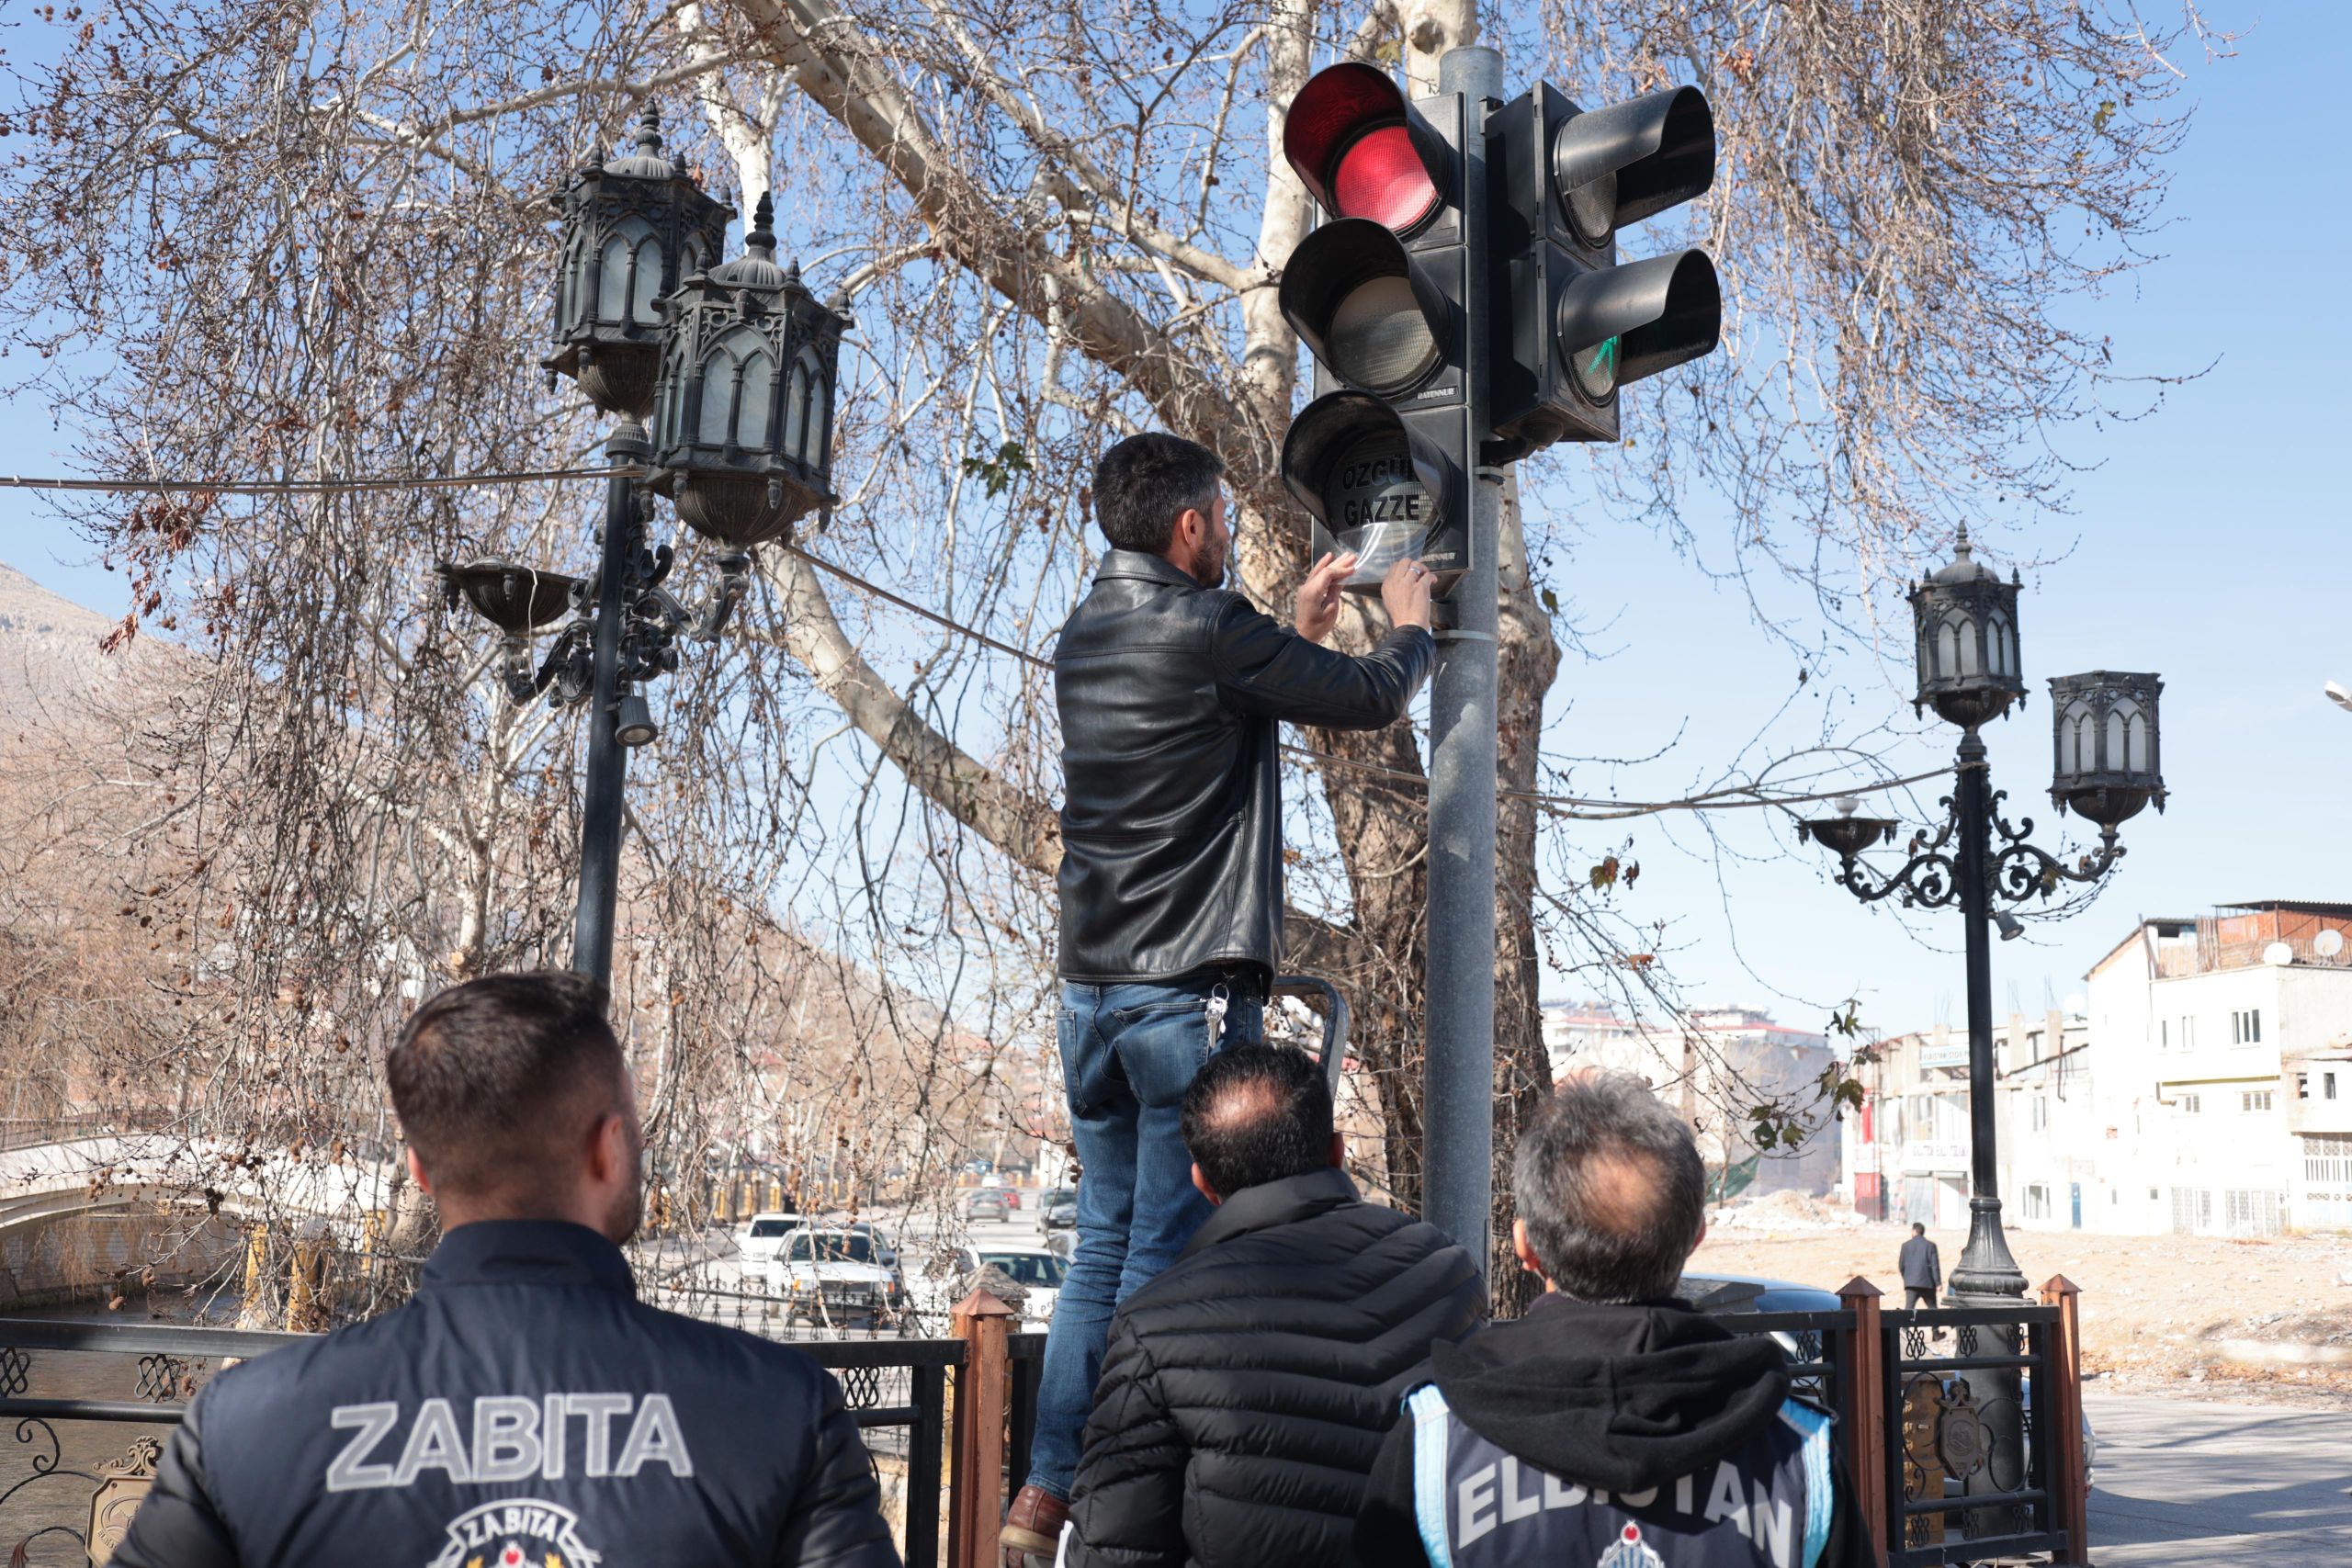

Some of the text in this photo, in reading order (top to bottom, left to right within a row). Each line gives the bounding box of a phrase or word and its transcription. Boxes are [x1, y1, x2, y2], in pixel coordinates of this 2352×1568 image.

[1344, 494, 1419, 526] GAZZE
[326, 1392, 694, 1492] ZABITA
[1458, 1455, 1792, 1568] ELBTAN
